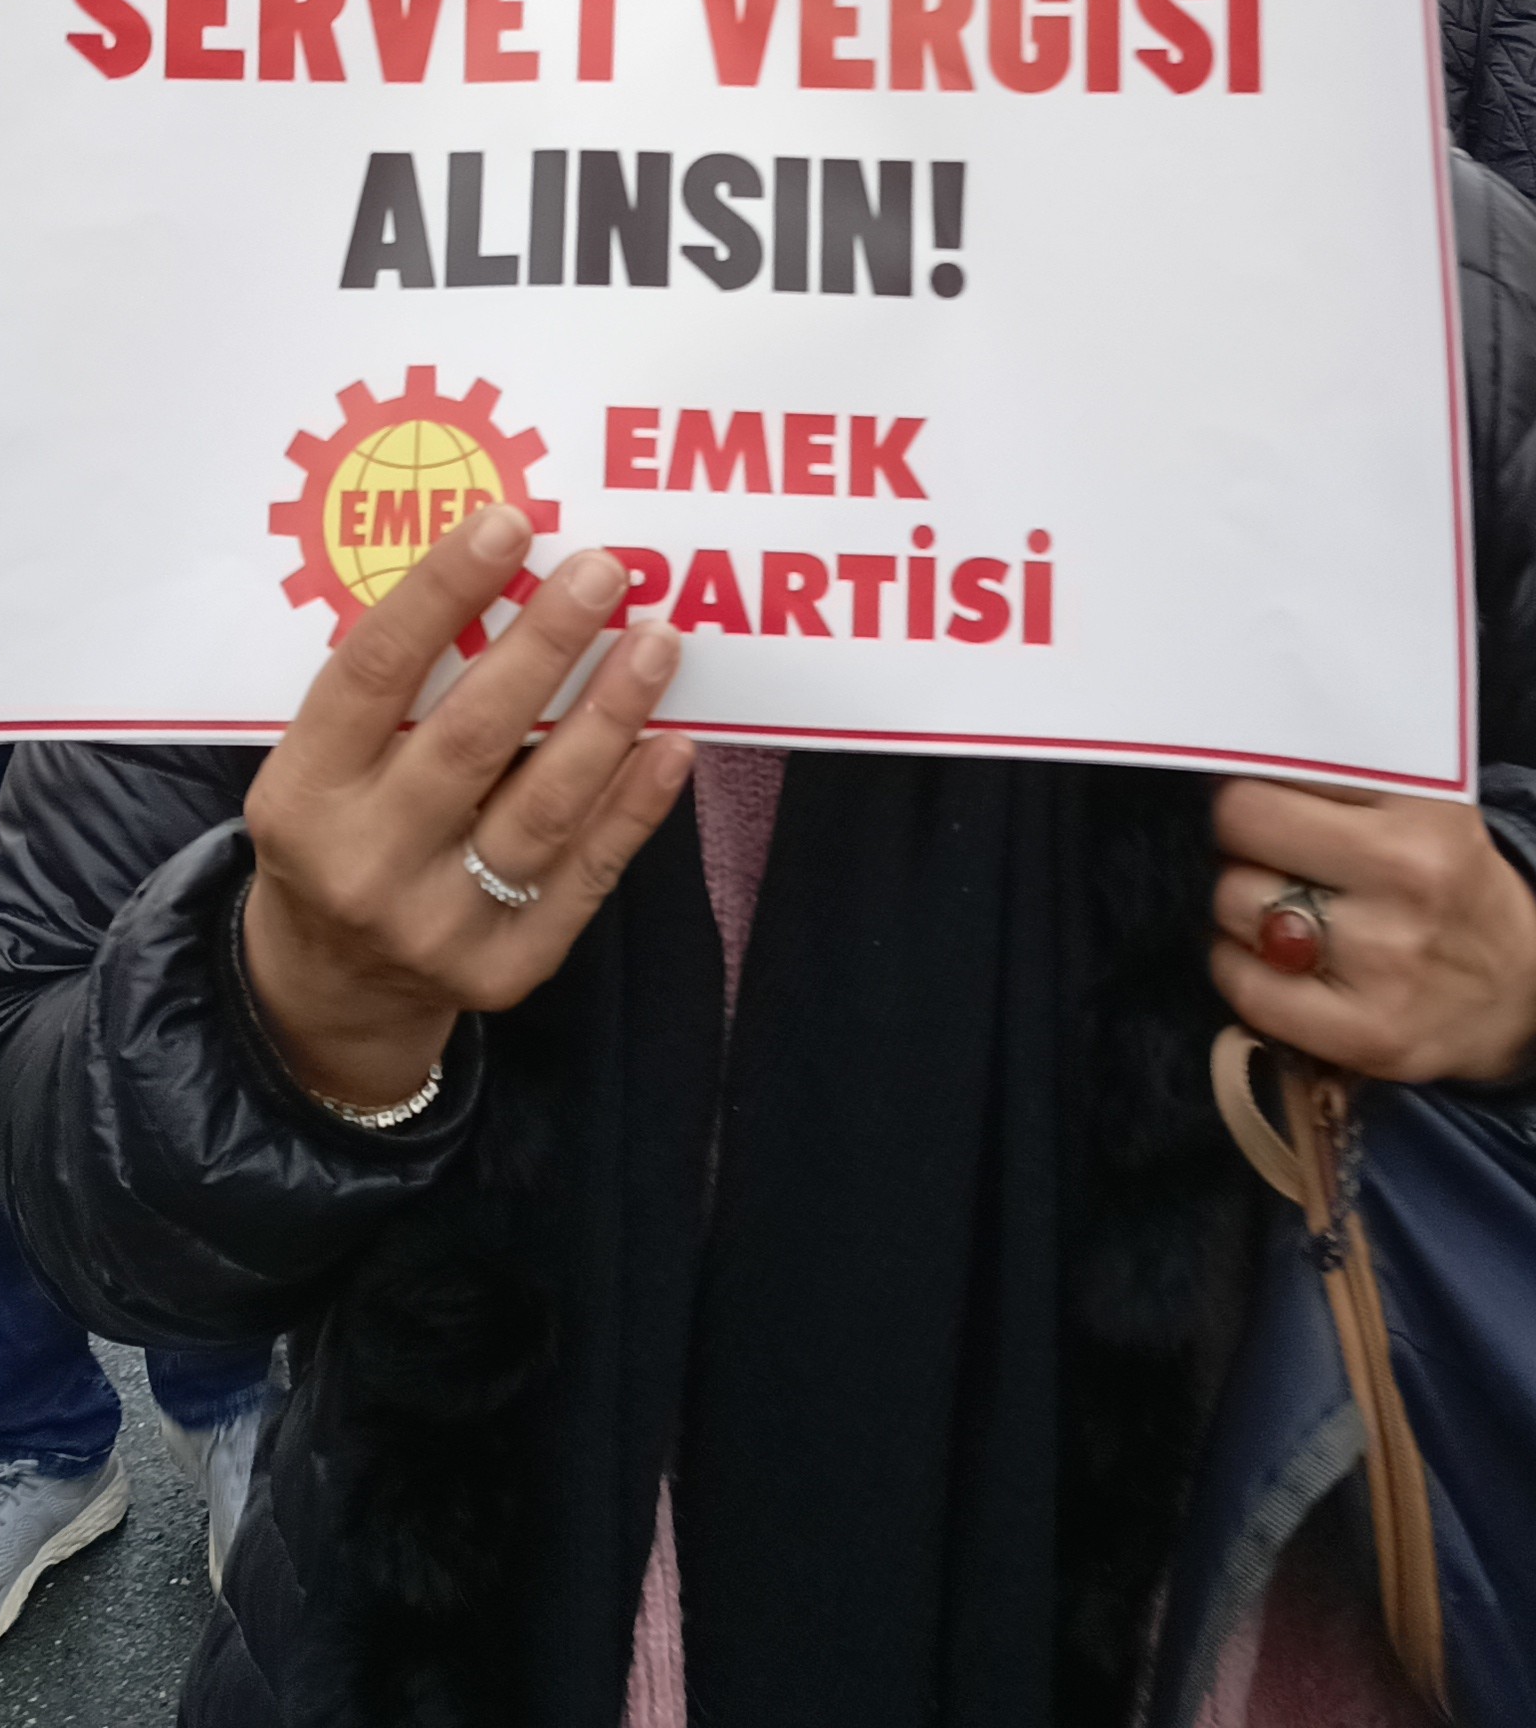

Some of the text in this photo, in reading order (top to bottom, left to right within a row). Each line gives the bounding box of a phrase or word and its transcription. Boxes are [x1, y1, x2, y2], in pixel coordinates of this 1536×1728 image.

[340, 149, 966, 299] ALINSIN!
[604, 406, 928, 500] EMEK
[602, 525, 1054, 646] PARTİSİ
